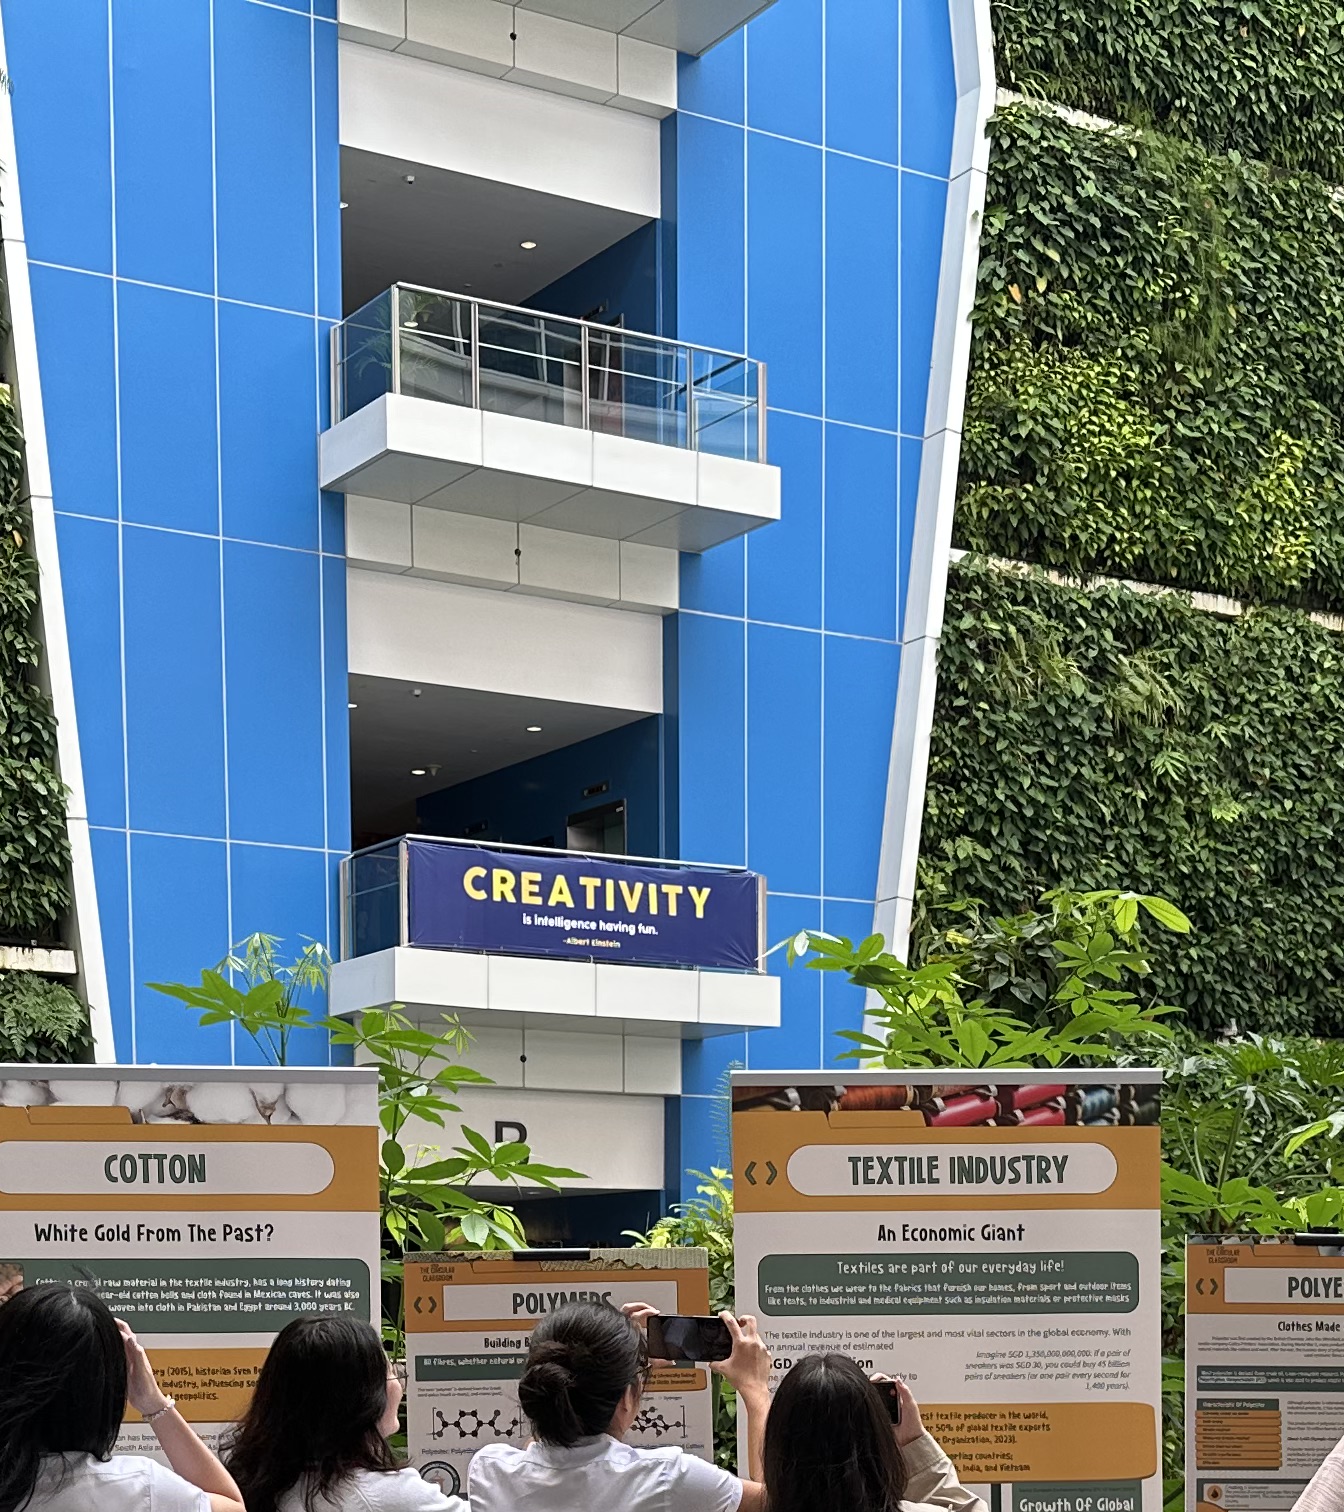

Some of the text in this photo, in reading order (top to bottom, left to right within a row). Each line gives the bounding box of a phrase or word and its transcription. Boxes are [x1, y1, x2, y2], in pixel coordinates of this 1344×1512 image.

[463, 866, 712, 919] CREATIVITY
[523, 913, 658, 935] is intelligence having fun.
[105, 1154, 206, 1183] COTTON
[848, 1155, 1068, 1185] TEXTILE INDUSTRY
[35, 1224, 273, 1242] White Gold From The Past?
[878, 1224, 1025, 1241] An Economic Giant
[838, 1260, 1063, 1274] Textiles are part of our everyday life!
[1278, 1321, 1312, 1332] Clothes
[1316, 1321, 1340, 1332] Made
[1020, 1497, 1133, 1512] Growth Of Global
